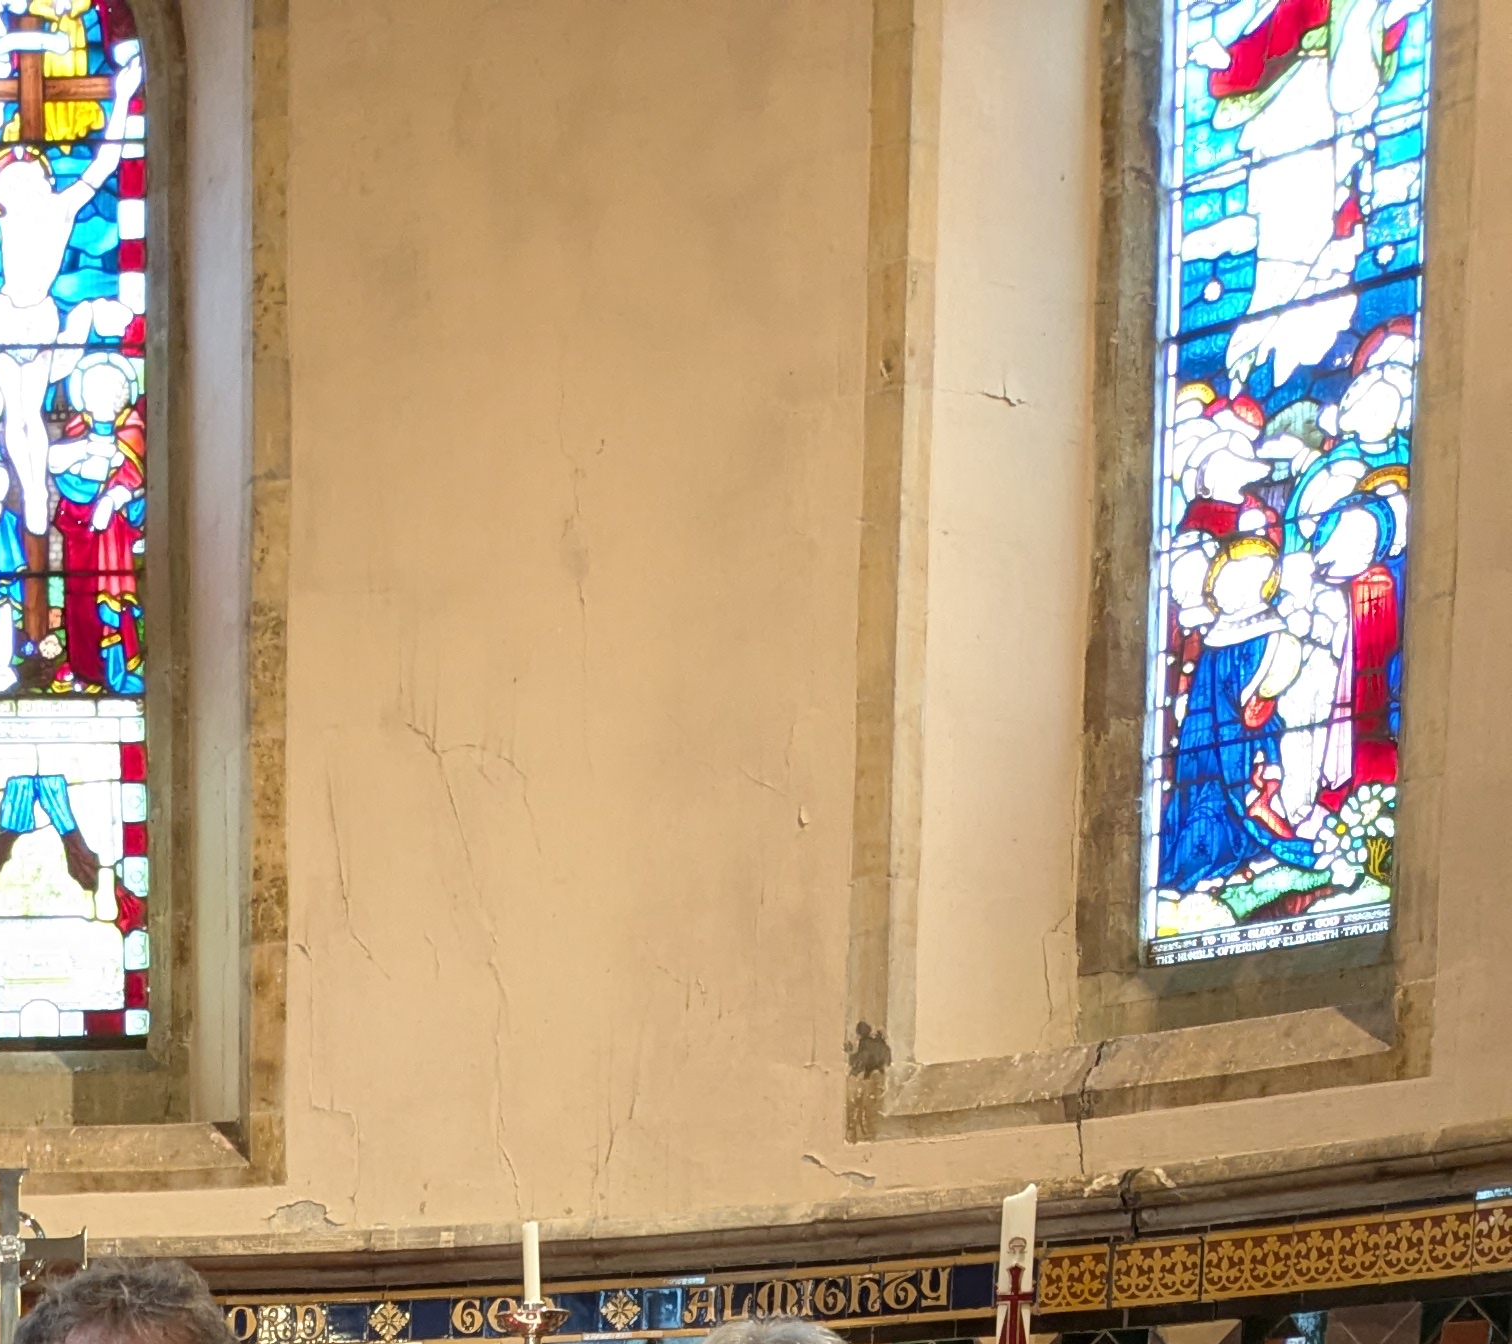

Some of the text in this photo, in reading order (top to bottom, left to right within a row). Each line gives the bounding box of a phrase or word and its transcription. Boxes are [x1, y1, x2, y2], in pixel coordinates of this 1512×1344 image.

[226, 1303, 326, 1343] ORD
[451, 1297, 555, 1335] GO
[683, 1265, 952, 1324] ALMIGHTY
